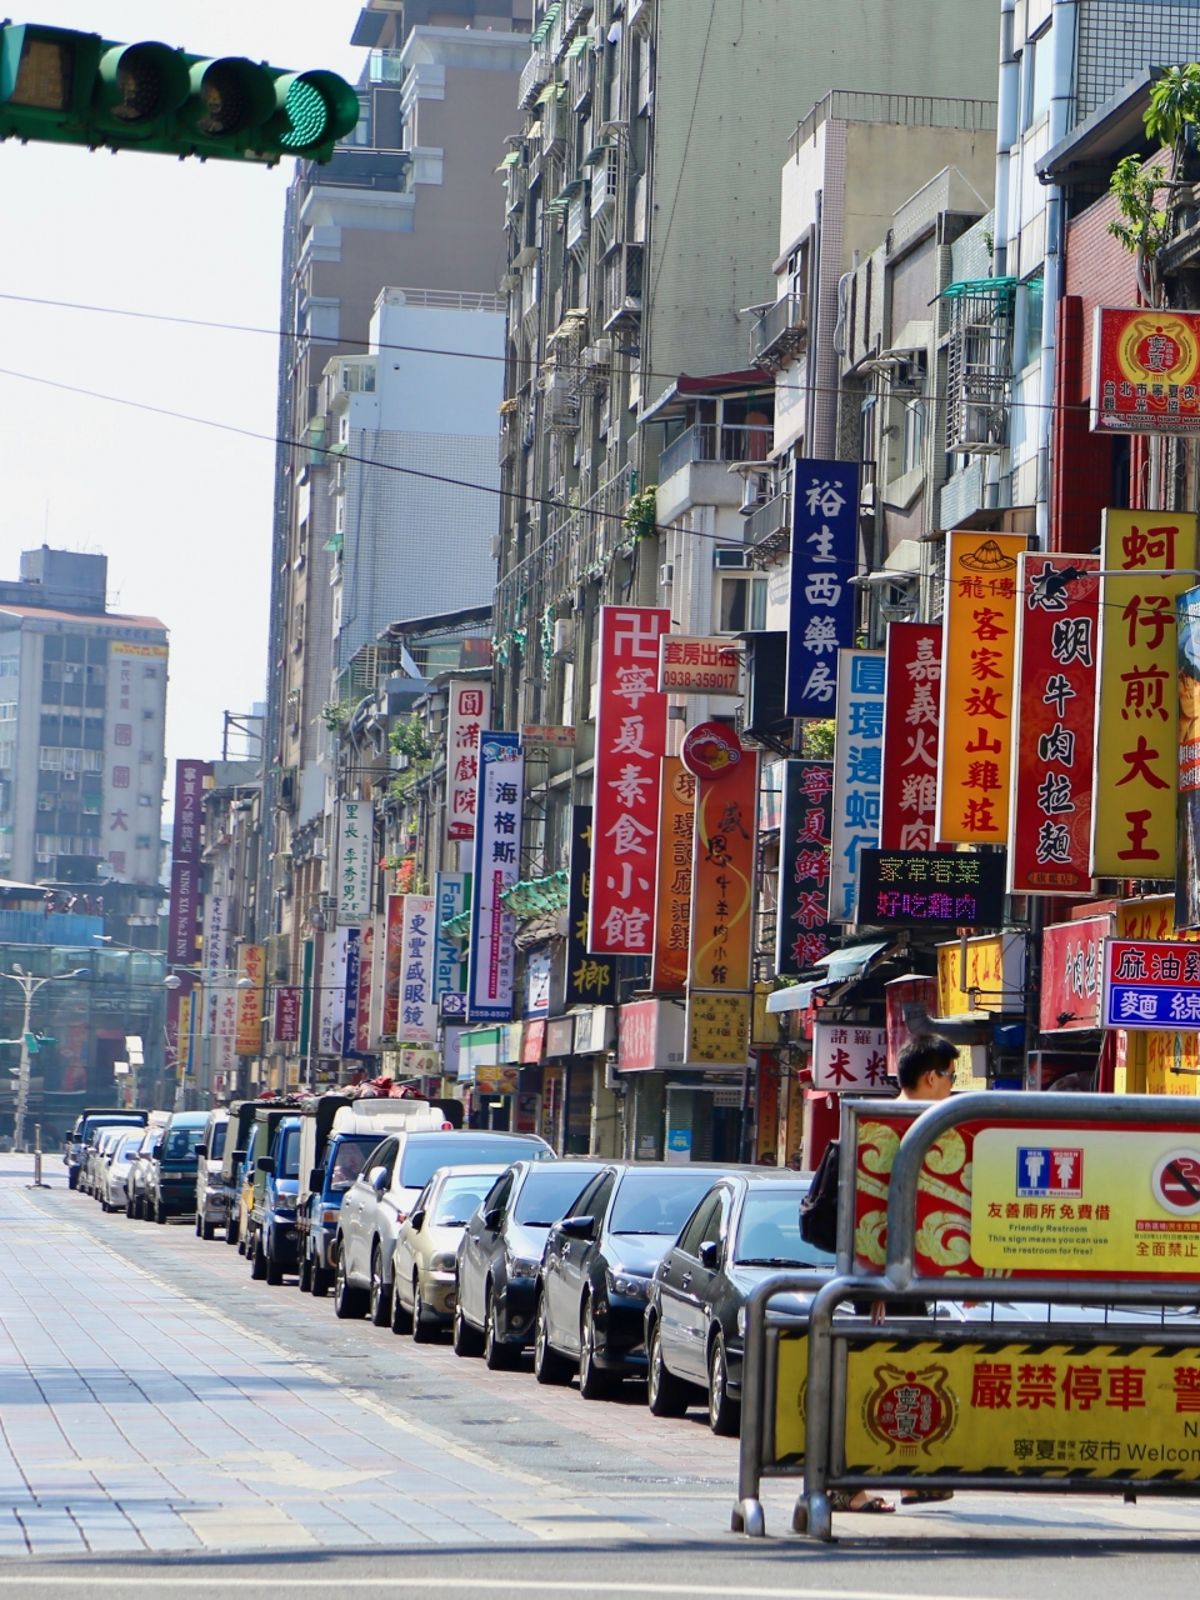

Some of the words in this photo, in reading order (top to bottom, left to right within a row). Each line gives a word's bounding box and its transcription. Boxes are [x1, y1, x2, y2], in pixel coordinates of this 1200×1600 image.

[801, 478, 846, 701] 裕生西藥房
[665, 642, 737, 668] 套房出租
[664, 670, 735, 690] 0938-359017
[1115, 526, 1179, 861] 蚵仔煎大王
[961, 608, 1008, 833] 客家放山雞莊
[492, 782, 518, 865] 海格斯
[877, 891, 976, 919] 好吃雞肉
[987, 1203, 1111, 1221] 友善廁所免費借
[988, 1235, 1008, 1243] This
[1011, 1235, 1026, 1246] sign
[1058, 1237, 1074, 1247] you
[1092, 1237, 1108, 1245] use
[1009, 1224, 1043, 1235] Friendly
[1046, 1225, 1088, 1234] Restroom
[1003, 1247, 1017, 1255] the
[1019, 1248, 1057, 1256] restroom
[1059, 1248, 1071, 1256] for
[970, 1363, 1146, 1413] 嚴禁停車
